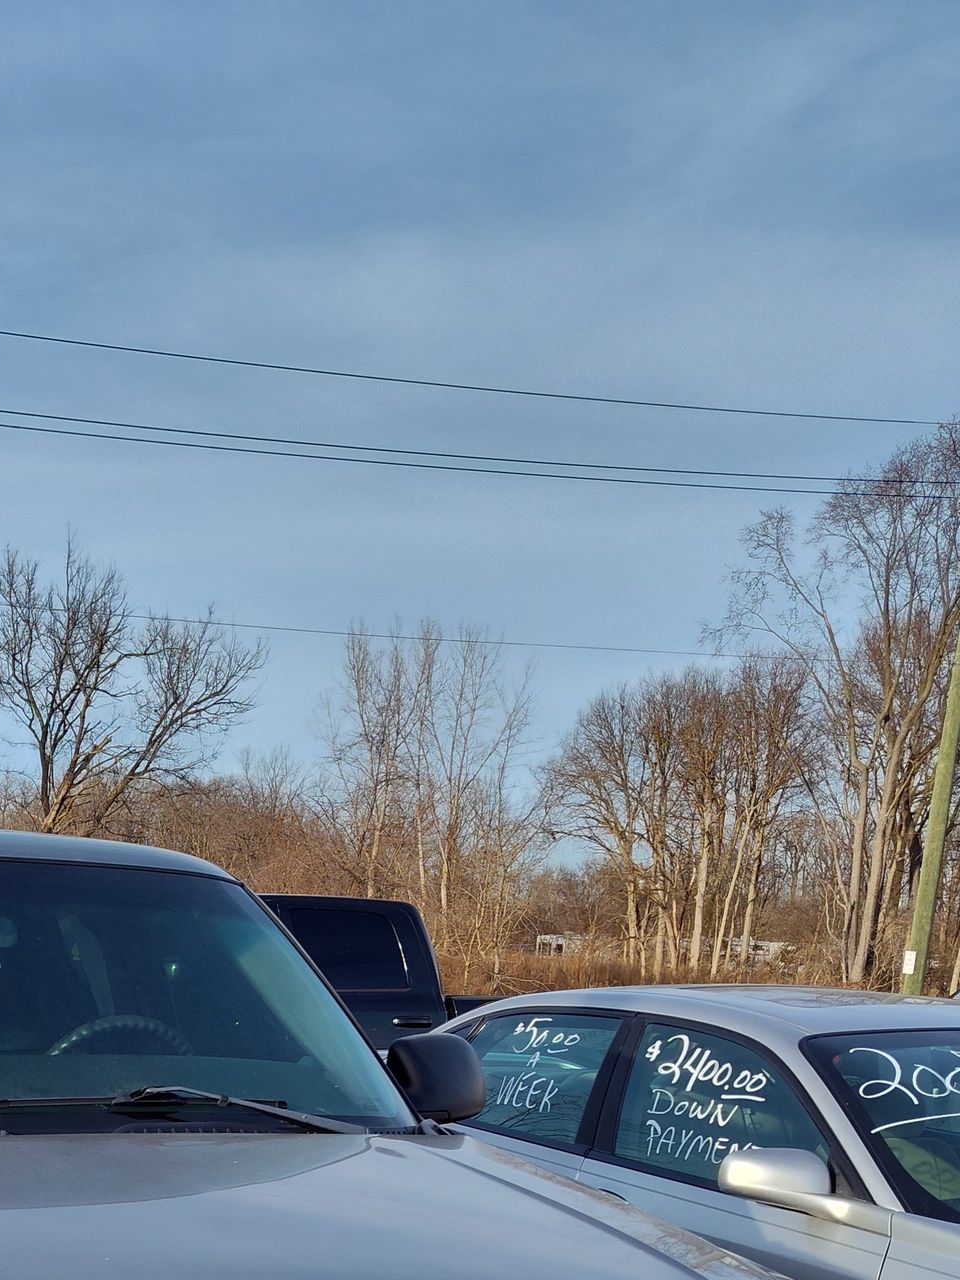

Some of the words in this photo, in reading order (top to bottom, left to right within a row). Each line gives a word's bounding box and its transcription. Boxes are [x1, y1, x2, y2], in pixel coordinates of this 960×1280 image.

[512, 1018, 581, 1053] $50.00
[526, 1050, 541, 1069] A
[644, 1034, 767, 1092] $2400.00
[495, 1071, 559, 1113] WEEK
[646, 1088, 739, 1127] DOWN
[645, 1119, 763, 1164] PAYME
